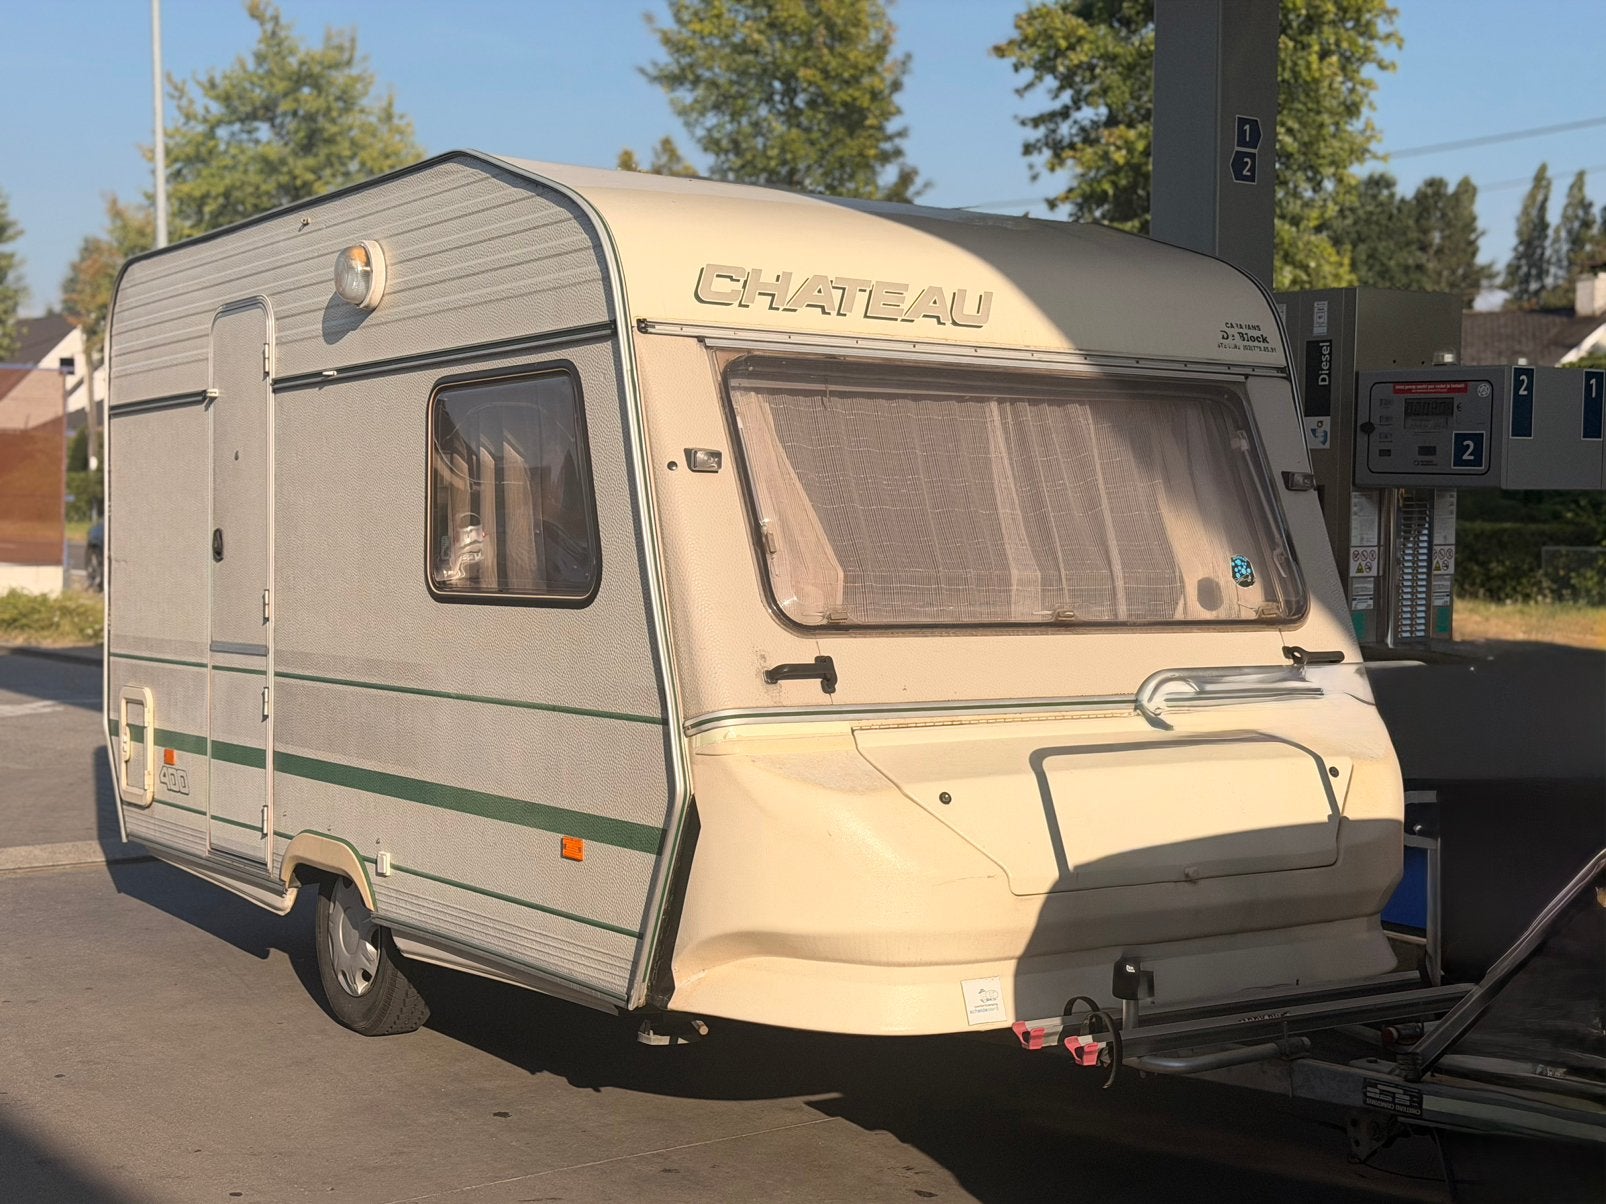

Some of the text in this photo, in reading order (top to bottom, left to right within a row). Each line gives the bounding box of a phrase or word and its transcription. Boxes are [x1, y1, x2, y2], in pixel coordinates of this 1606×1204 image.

[1243, 124, 1250, 142] 1
[1242, 158, 1252, 176] 2
[694, 263, 993, 329] CHATEAU
[1237, 332, 1270, 344] Block
[1318, 342, 1331, 386] Diesel
[1518, 375, 1528, 395] 2
[1589, 378, 1597, 398] 1
[1462, 440, 1475, 460] 2
[159, 765, 190, 795] 400
